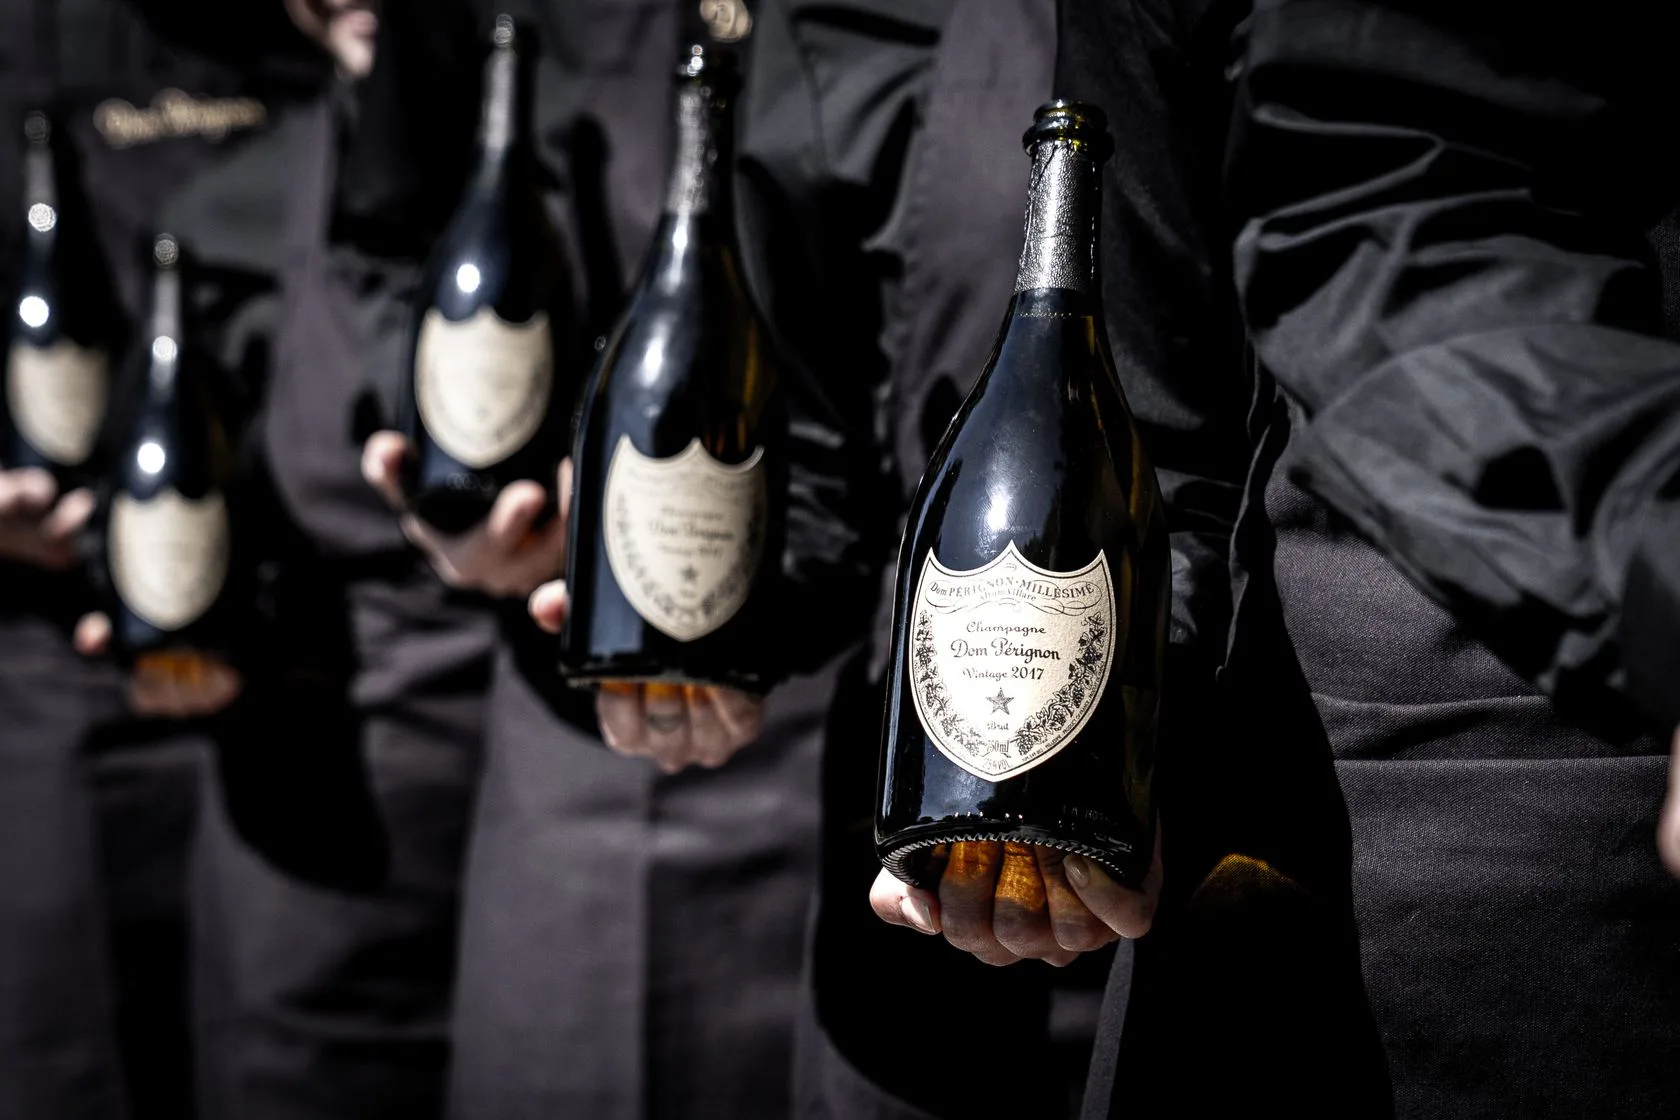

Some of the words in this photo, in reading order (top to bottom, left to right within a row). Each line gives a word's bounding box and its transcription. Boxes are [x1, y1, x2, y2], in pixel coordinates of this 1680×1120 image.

[966, 621, 1046, 636] Champagne
[950, 638, 988, 659] Dom
[991, 637, 1061, 663] Pérignon
[963, 668, 1008, 683] Vintage
[1011, 667, 1044, 681] 2017
